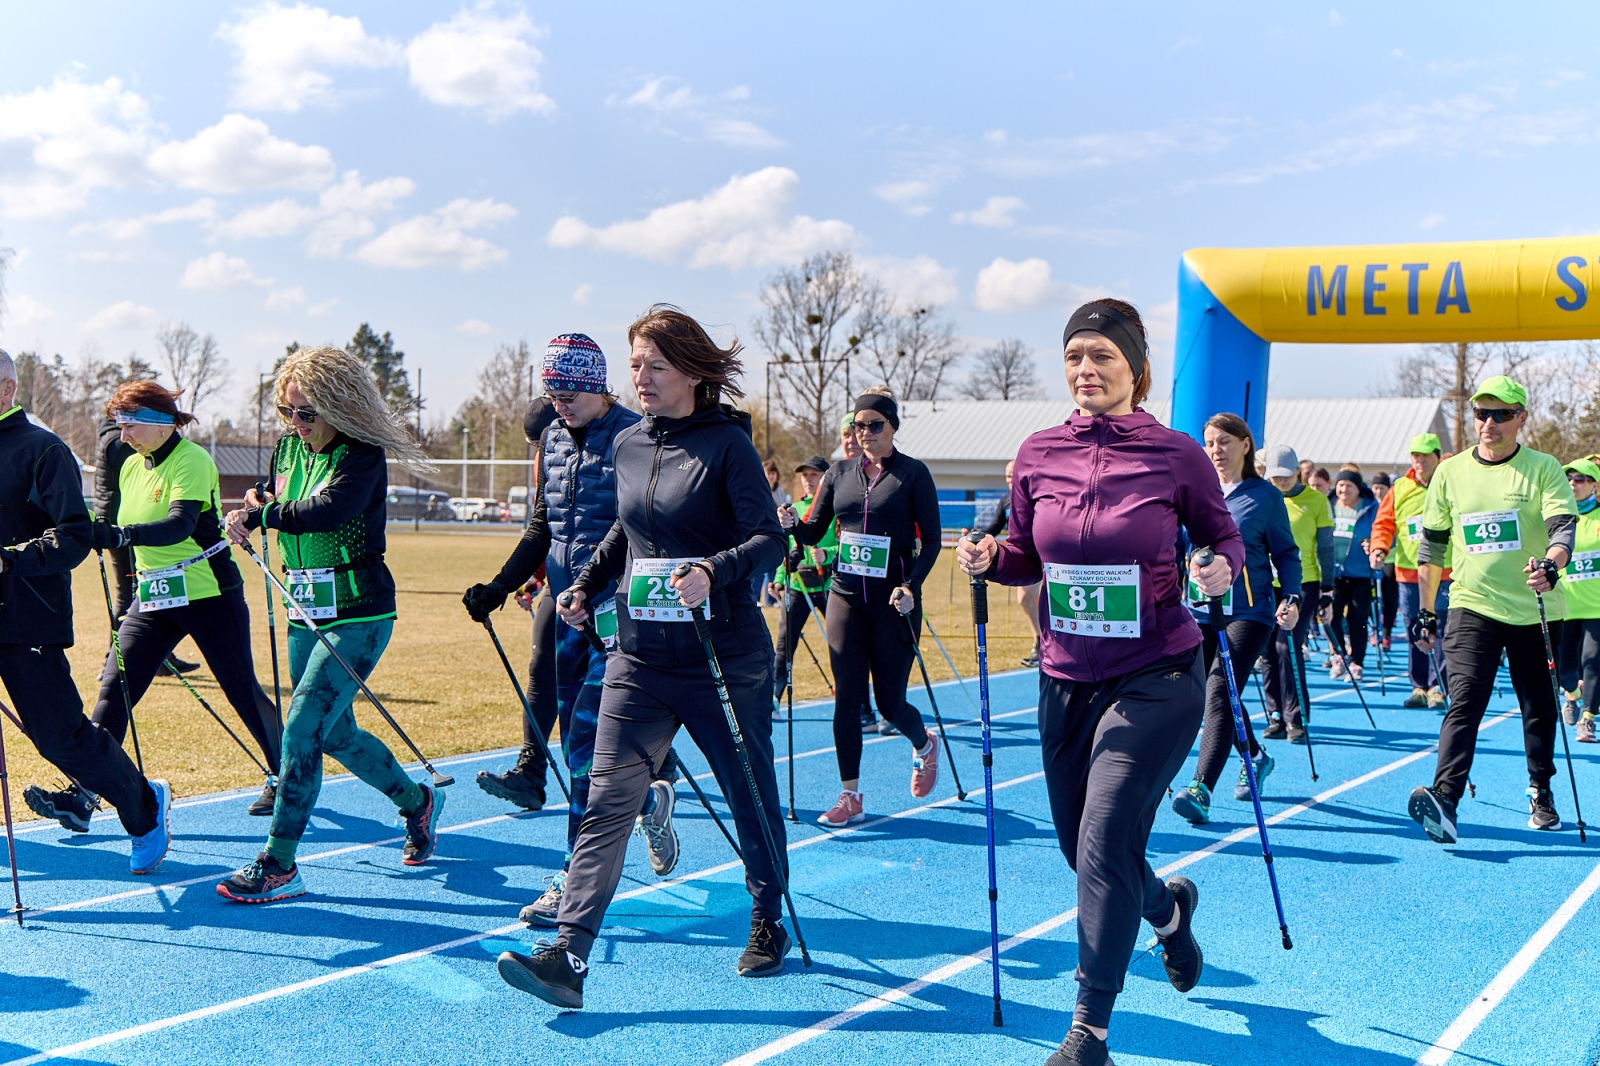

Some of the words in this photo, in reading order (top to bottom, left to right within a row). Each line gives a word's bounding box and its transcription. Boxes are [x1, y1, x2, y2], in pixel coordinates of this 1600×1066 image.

[1306, 261, 1471, 316] META
[1555, 256, 1600, 312] S
[1475, 522, 1502, 539] 49
[849, 545, 872, 562] 96
[1574, 559, 1594, 572] 82
[149, 578, 170, 596] 46
[293, 583, 315, 602] 44
[1068, 586, 1105, 612] 81
[1074, 611, 1105, 621] EDYTA
